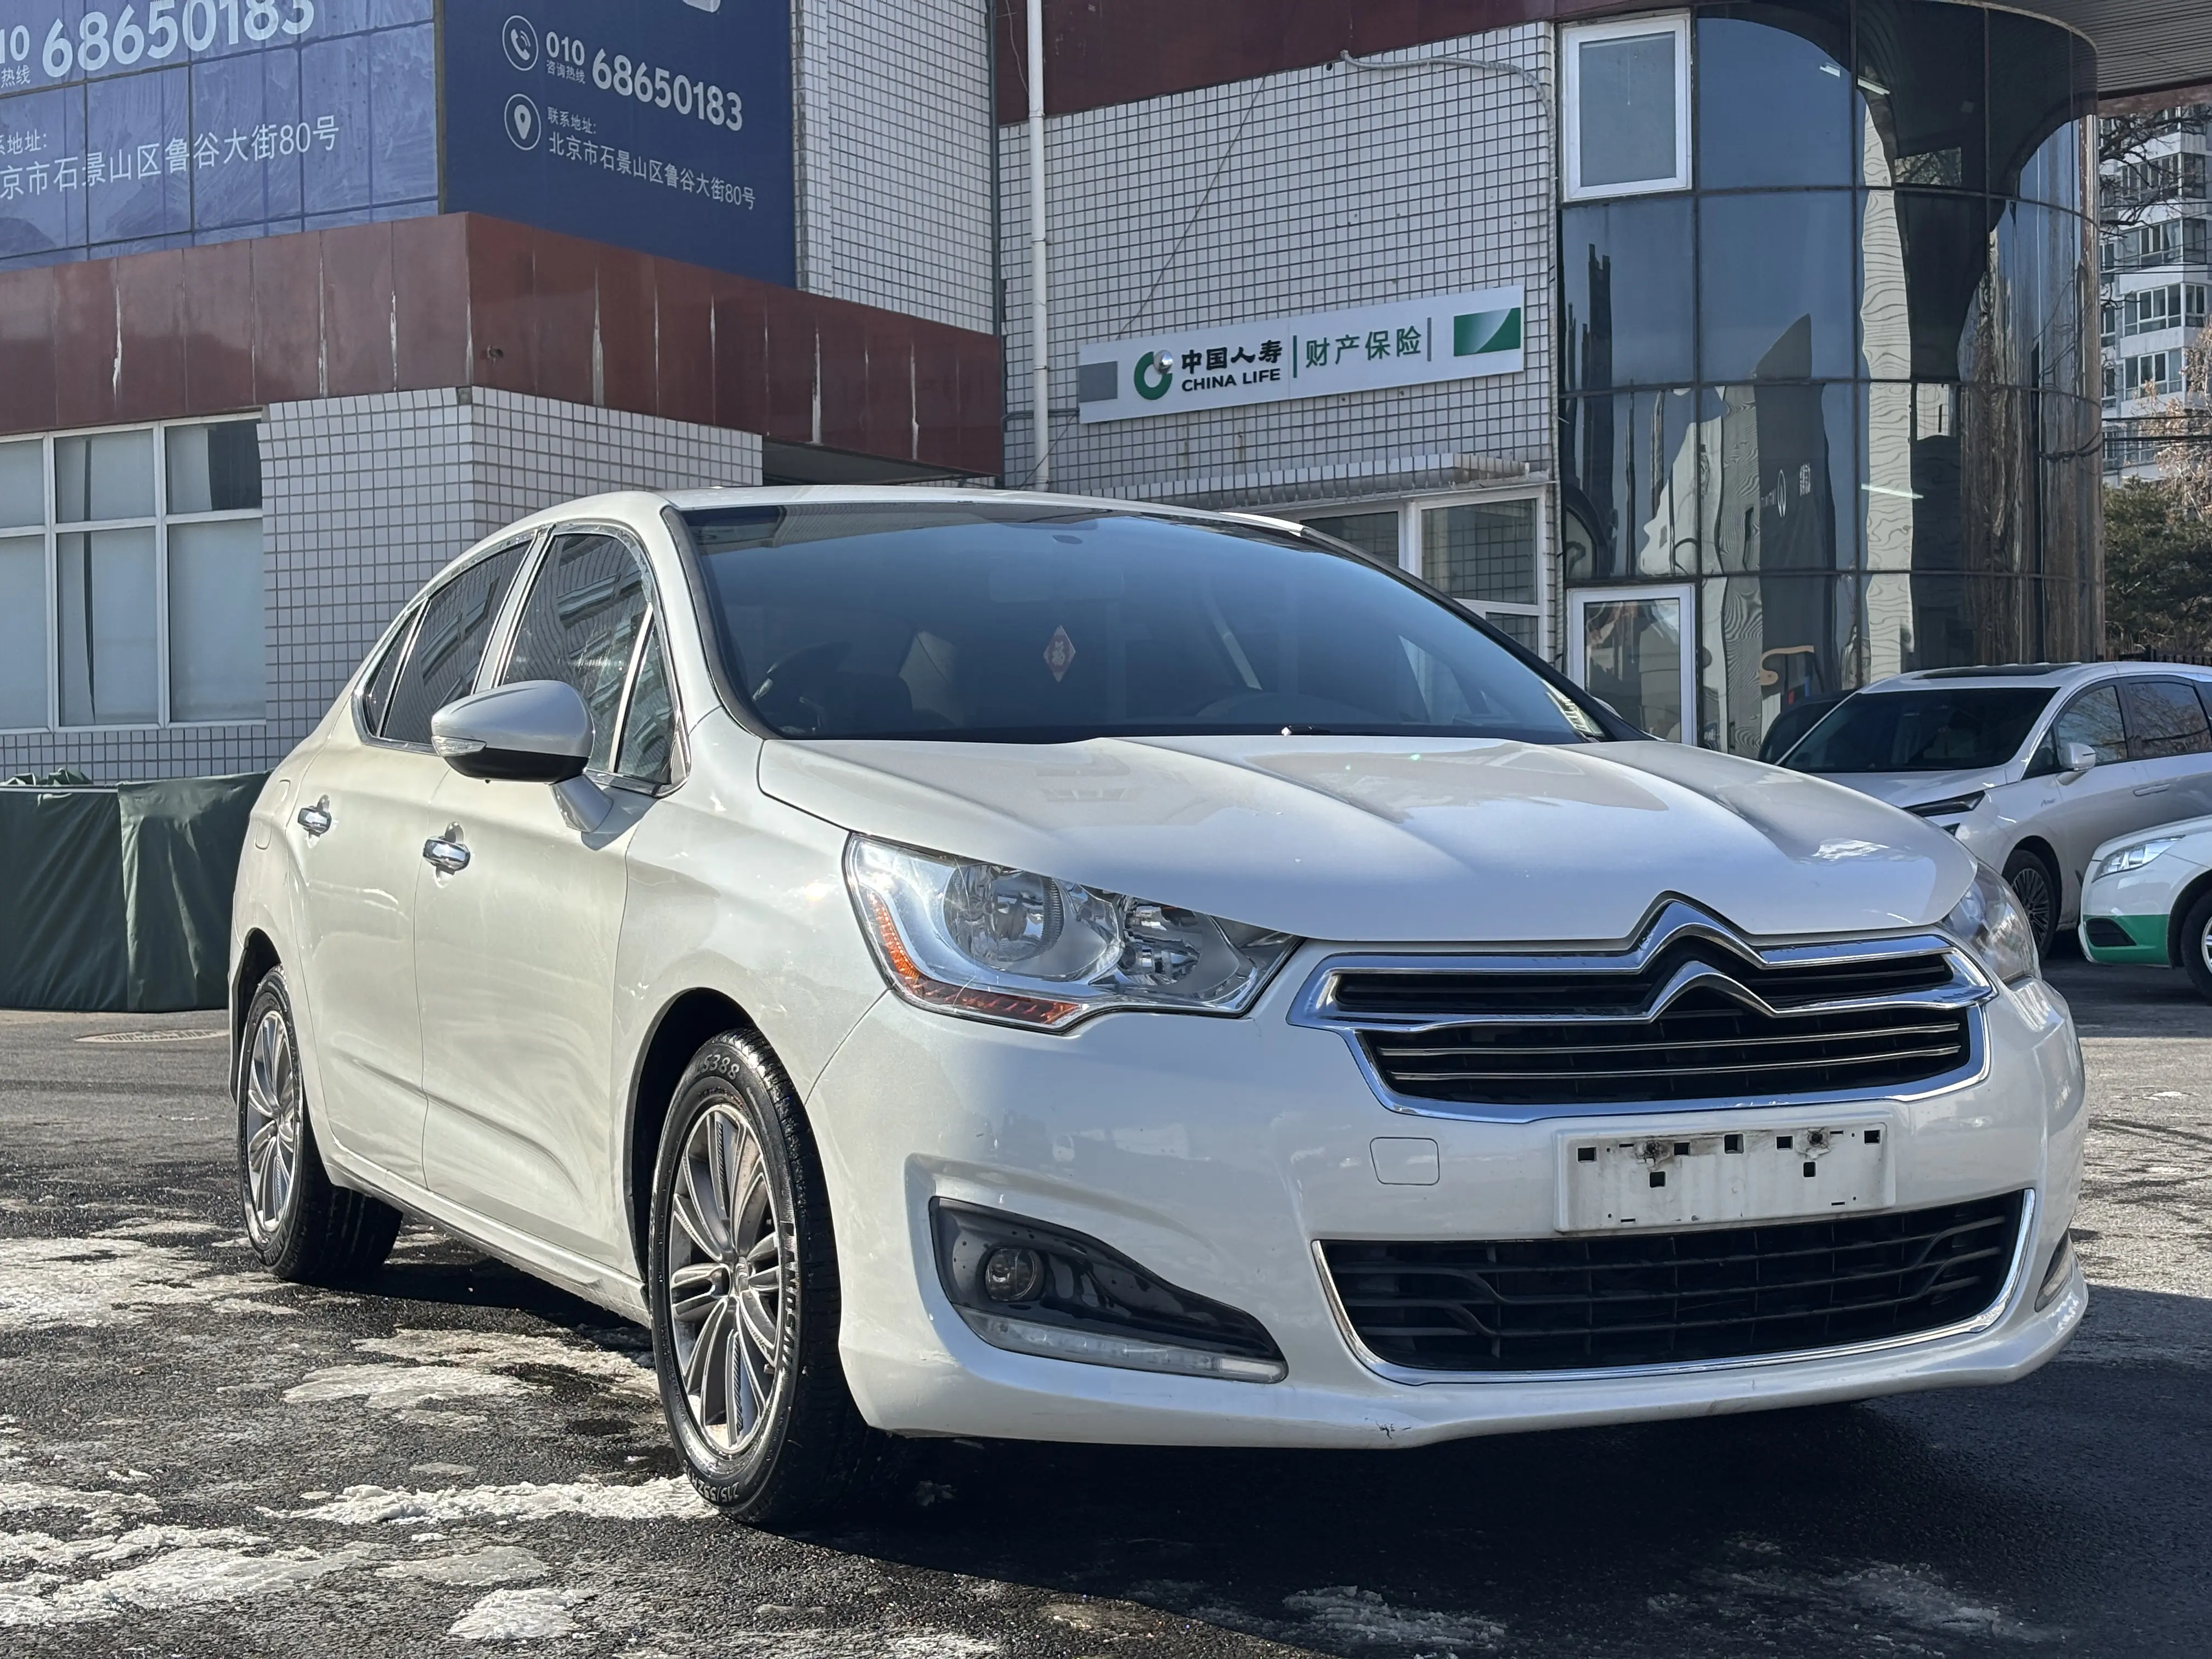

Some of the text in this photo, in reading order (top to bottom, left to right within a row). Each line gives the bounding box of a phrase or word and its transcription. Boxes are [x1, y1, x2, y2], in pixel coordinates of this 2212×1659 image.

[42, 0, 314, 77] 68650183
[1, 64, 31, 89] 热线
[546, 59, 585, 84] 咨询热线
[546, 31, 742, 131] 010 68650183
[548, 106, 596, 134] 联系地址：
[0, 115, 340, 200] 京市石景山区鲁谷大街80号
[549, 131, 755, 210] 北京市石景山区鲁谷大街80号
[1181, 339, 1283, 375] 中国人寿
[1305, 325, 1422, 368] 财产保险
[1181, 368, 1281, 392] CHINA LIFE
